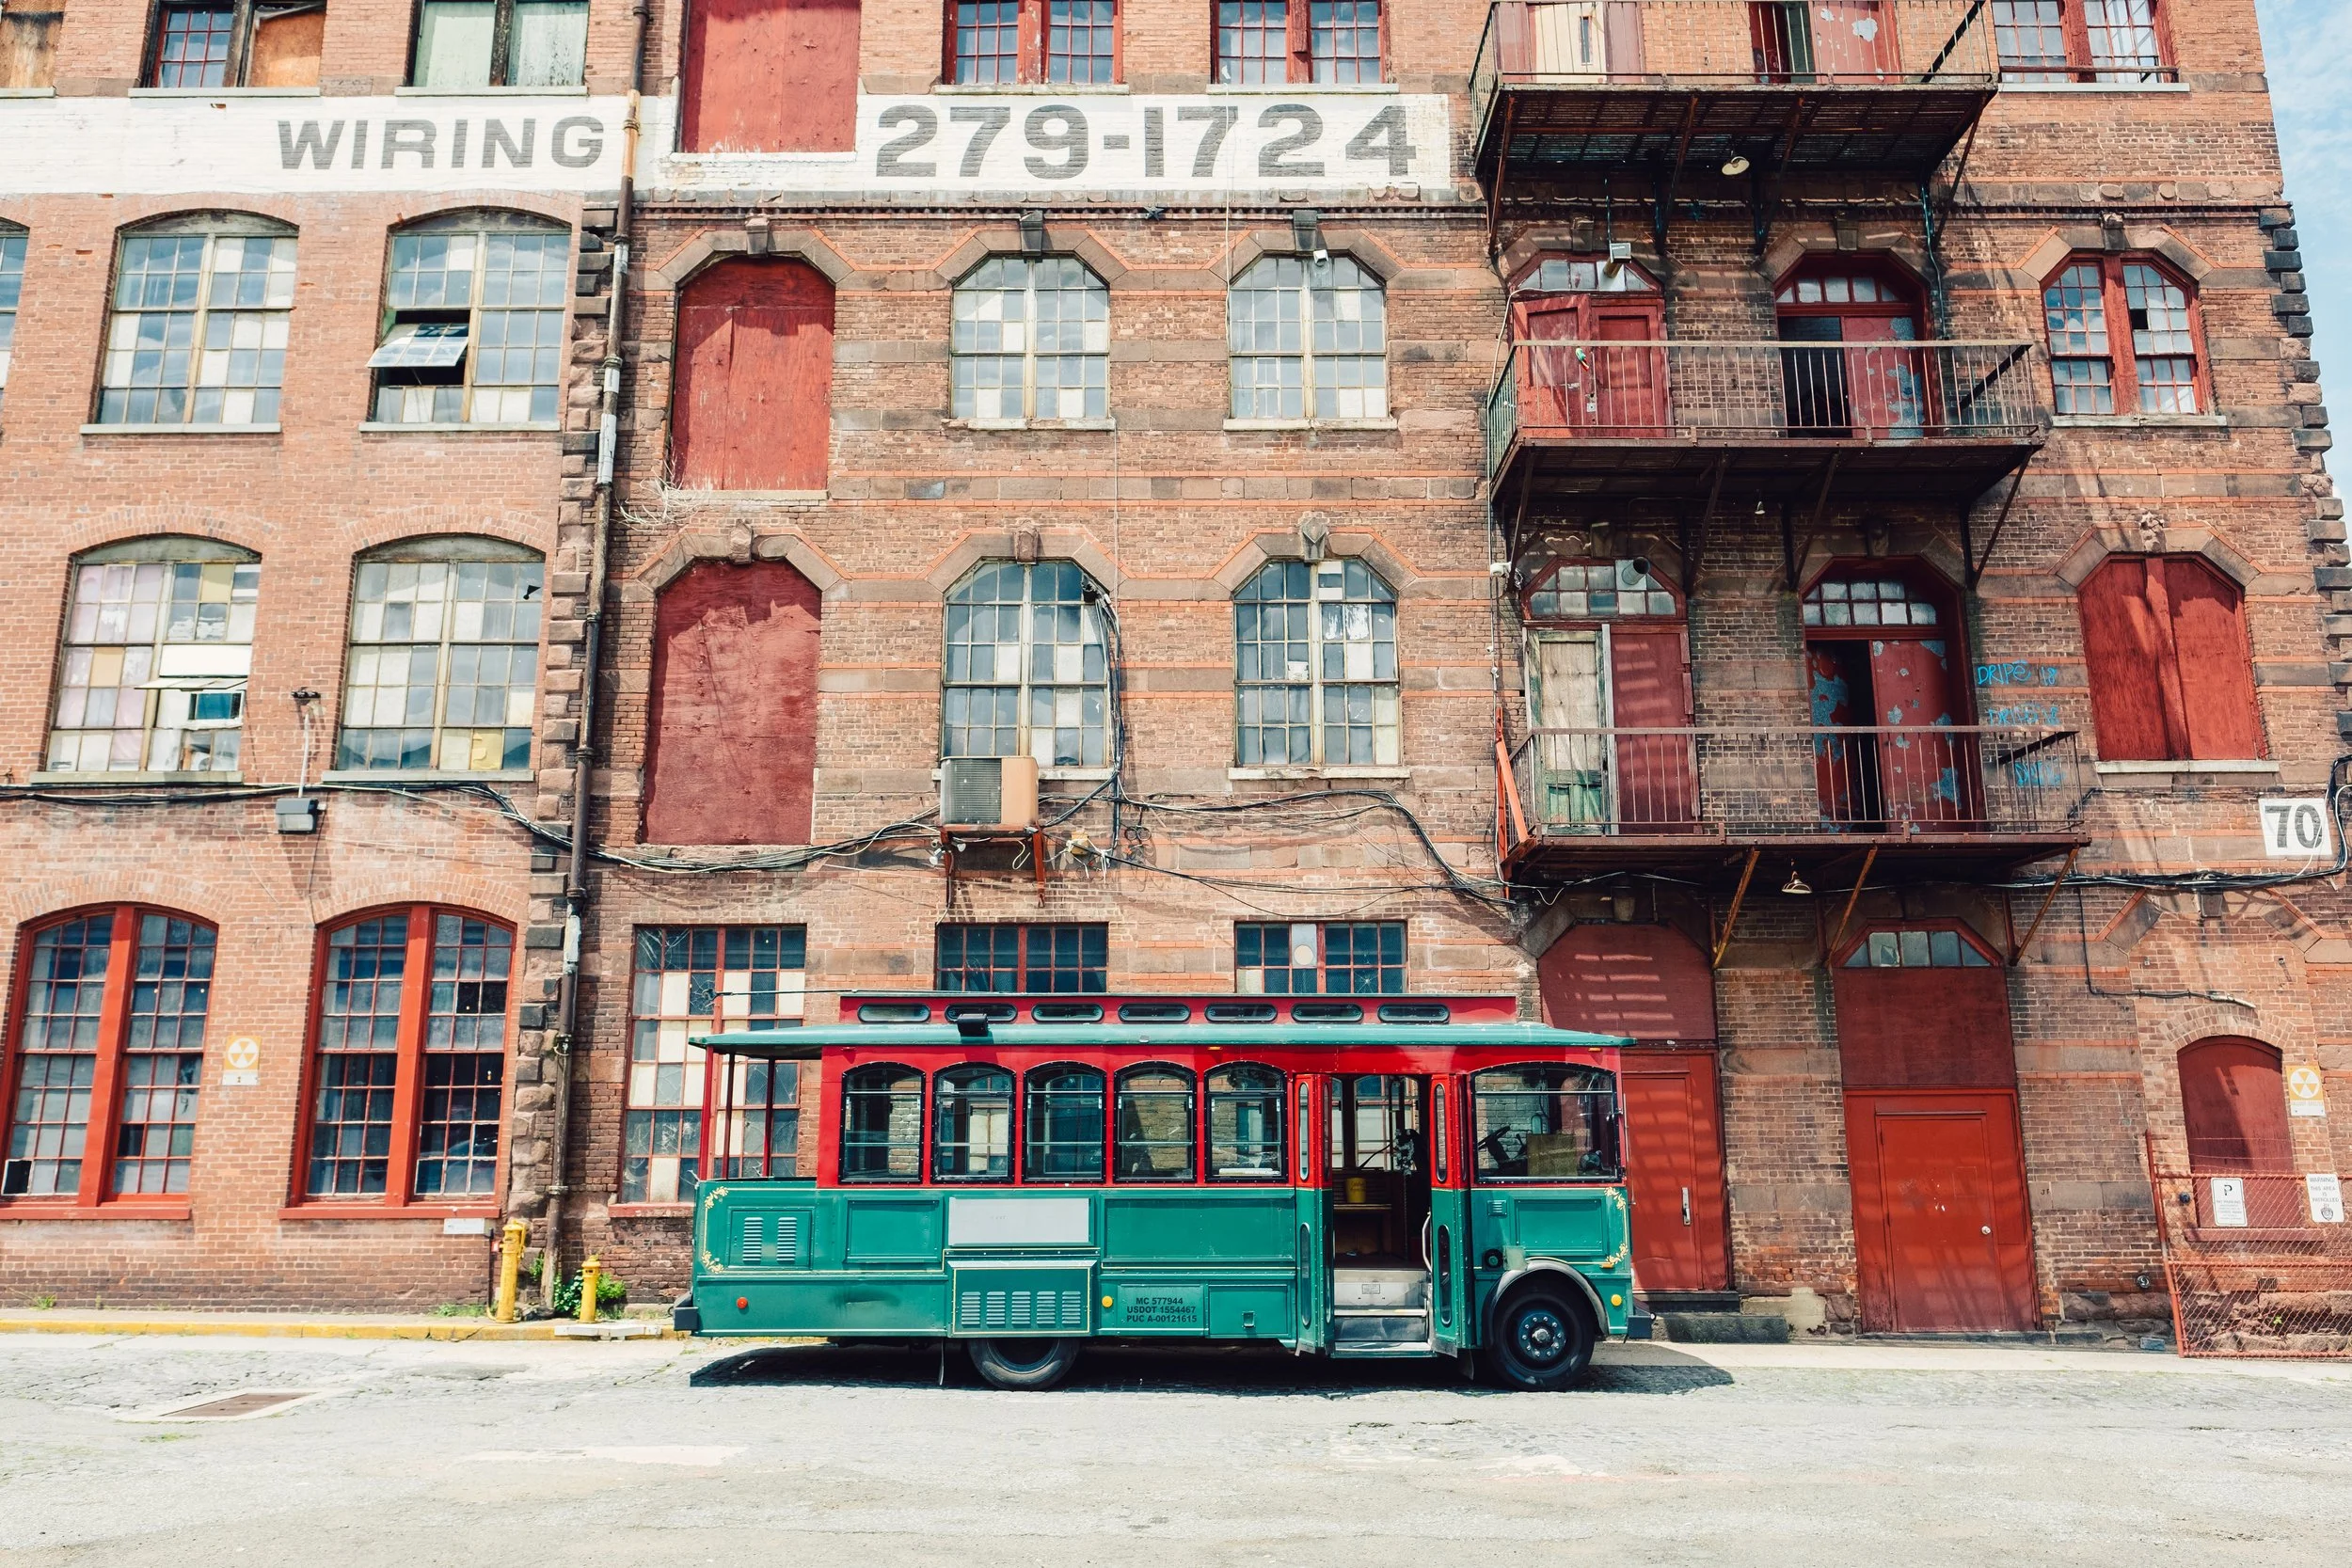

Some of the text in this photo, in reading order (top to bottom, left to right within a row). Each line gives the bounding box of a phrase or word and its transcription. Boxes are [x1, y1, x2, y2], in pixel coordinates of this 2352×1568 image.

[278, 116, 604, 169] WIRING
[876, 104, 1417, 180] 279-1724
[2265, 804, 2323, 848] 70
[2224, 1184, 2233, 1196] P
